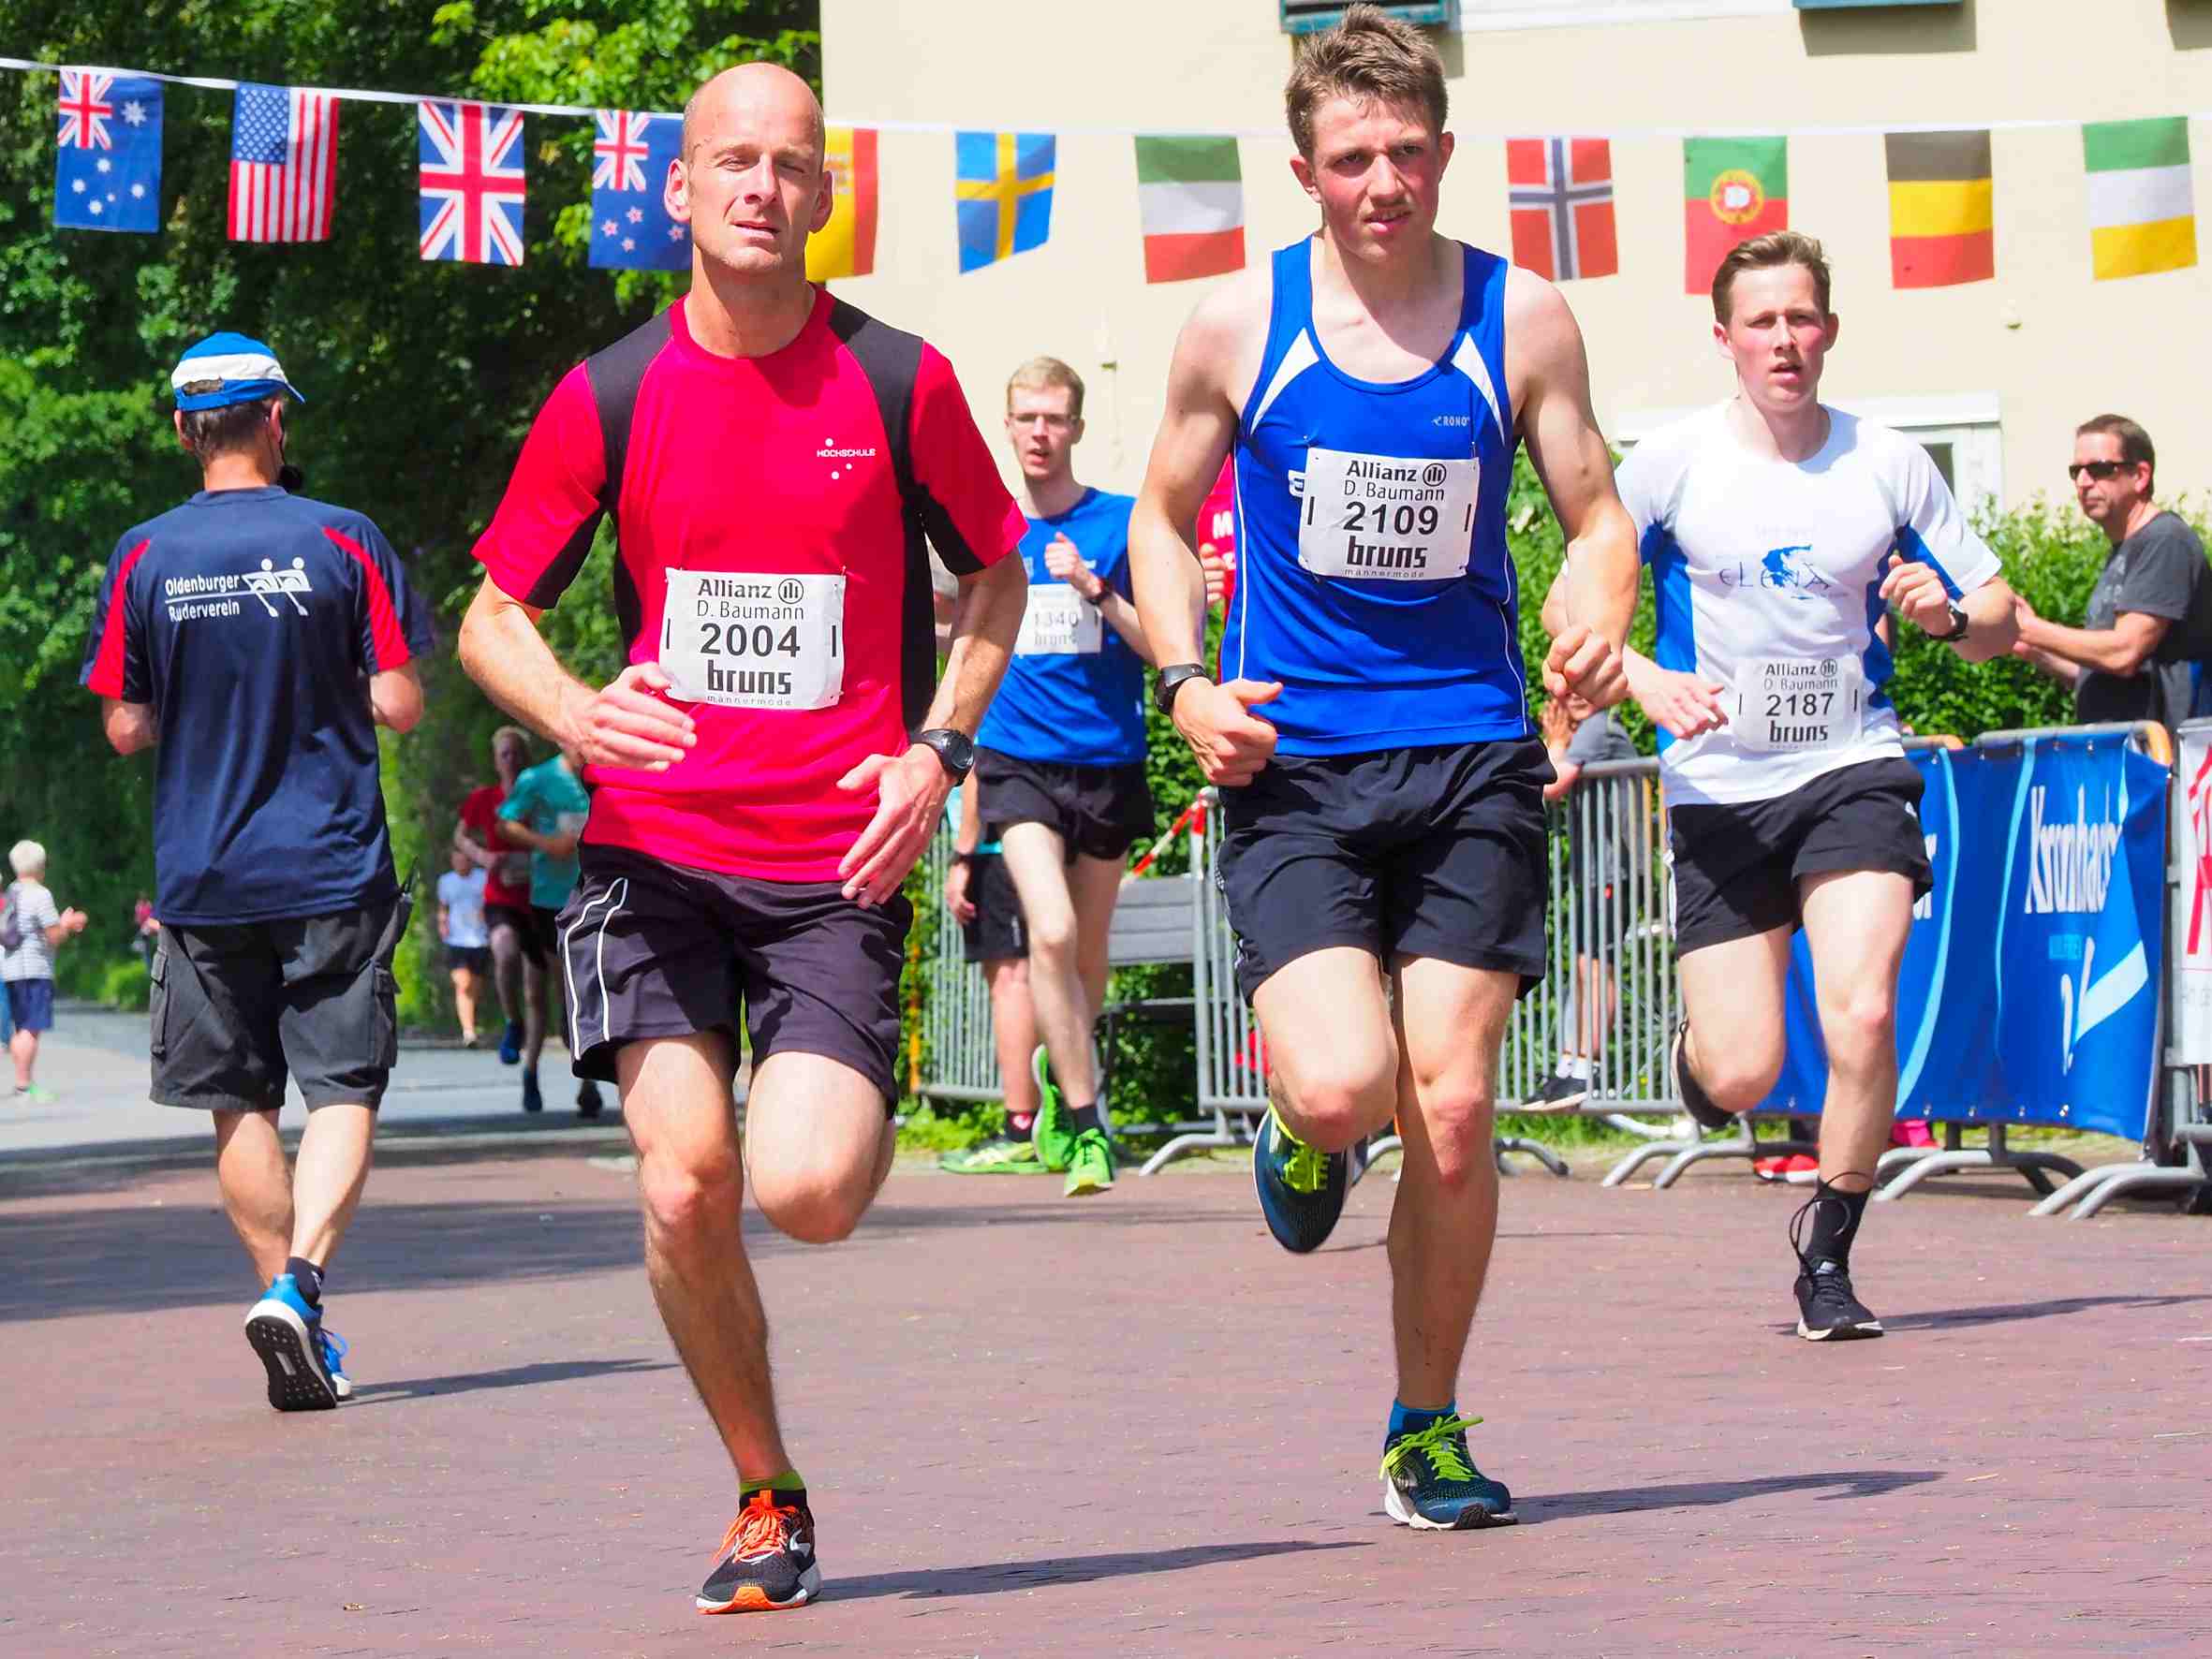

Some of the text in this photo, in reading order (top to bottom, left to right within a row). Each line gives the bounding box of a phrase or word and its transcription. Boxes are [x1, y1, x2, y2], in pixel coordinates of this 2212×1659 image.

[817, 448, 877, 458] HOCHSCHULE
[1346, 460, 1417, 482] Allianz
[1344, 479, 1445, 502] D. Baumann
[1343, 501, 1439, 536] 2109
[1346, 536, 1429, 569] bruns
[165, 574, 241, 597] Oldenburger
[697, 579, 773, 599] Allianz
[168, 599, 241, 623] Ruderverein
[697, 599, 804, 621] D. Baumann
[700, 623, 801, 658] 2004
[707, 659, 792, 695] bruns
[1765, 663, 1817, 676] Allianz
[1780, 678, 1838, 691] Baumann
[1765, 692, 1836, 717] 2187
[1769, 719, 1829, 742] bruns
